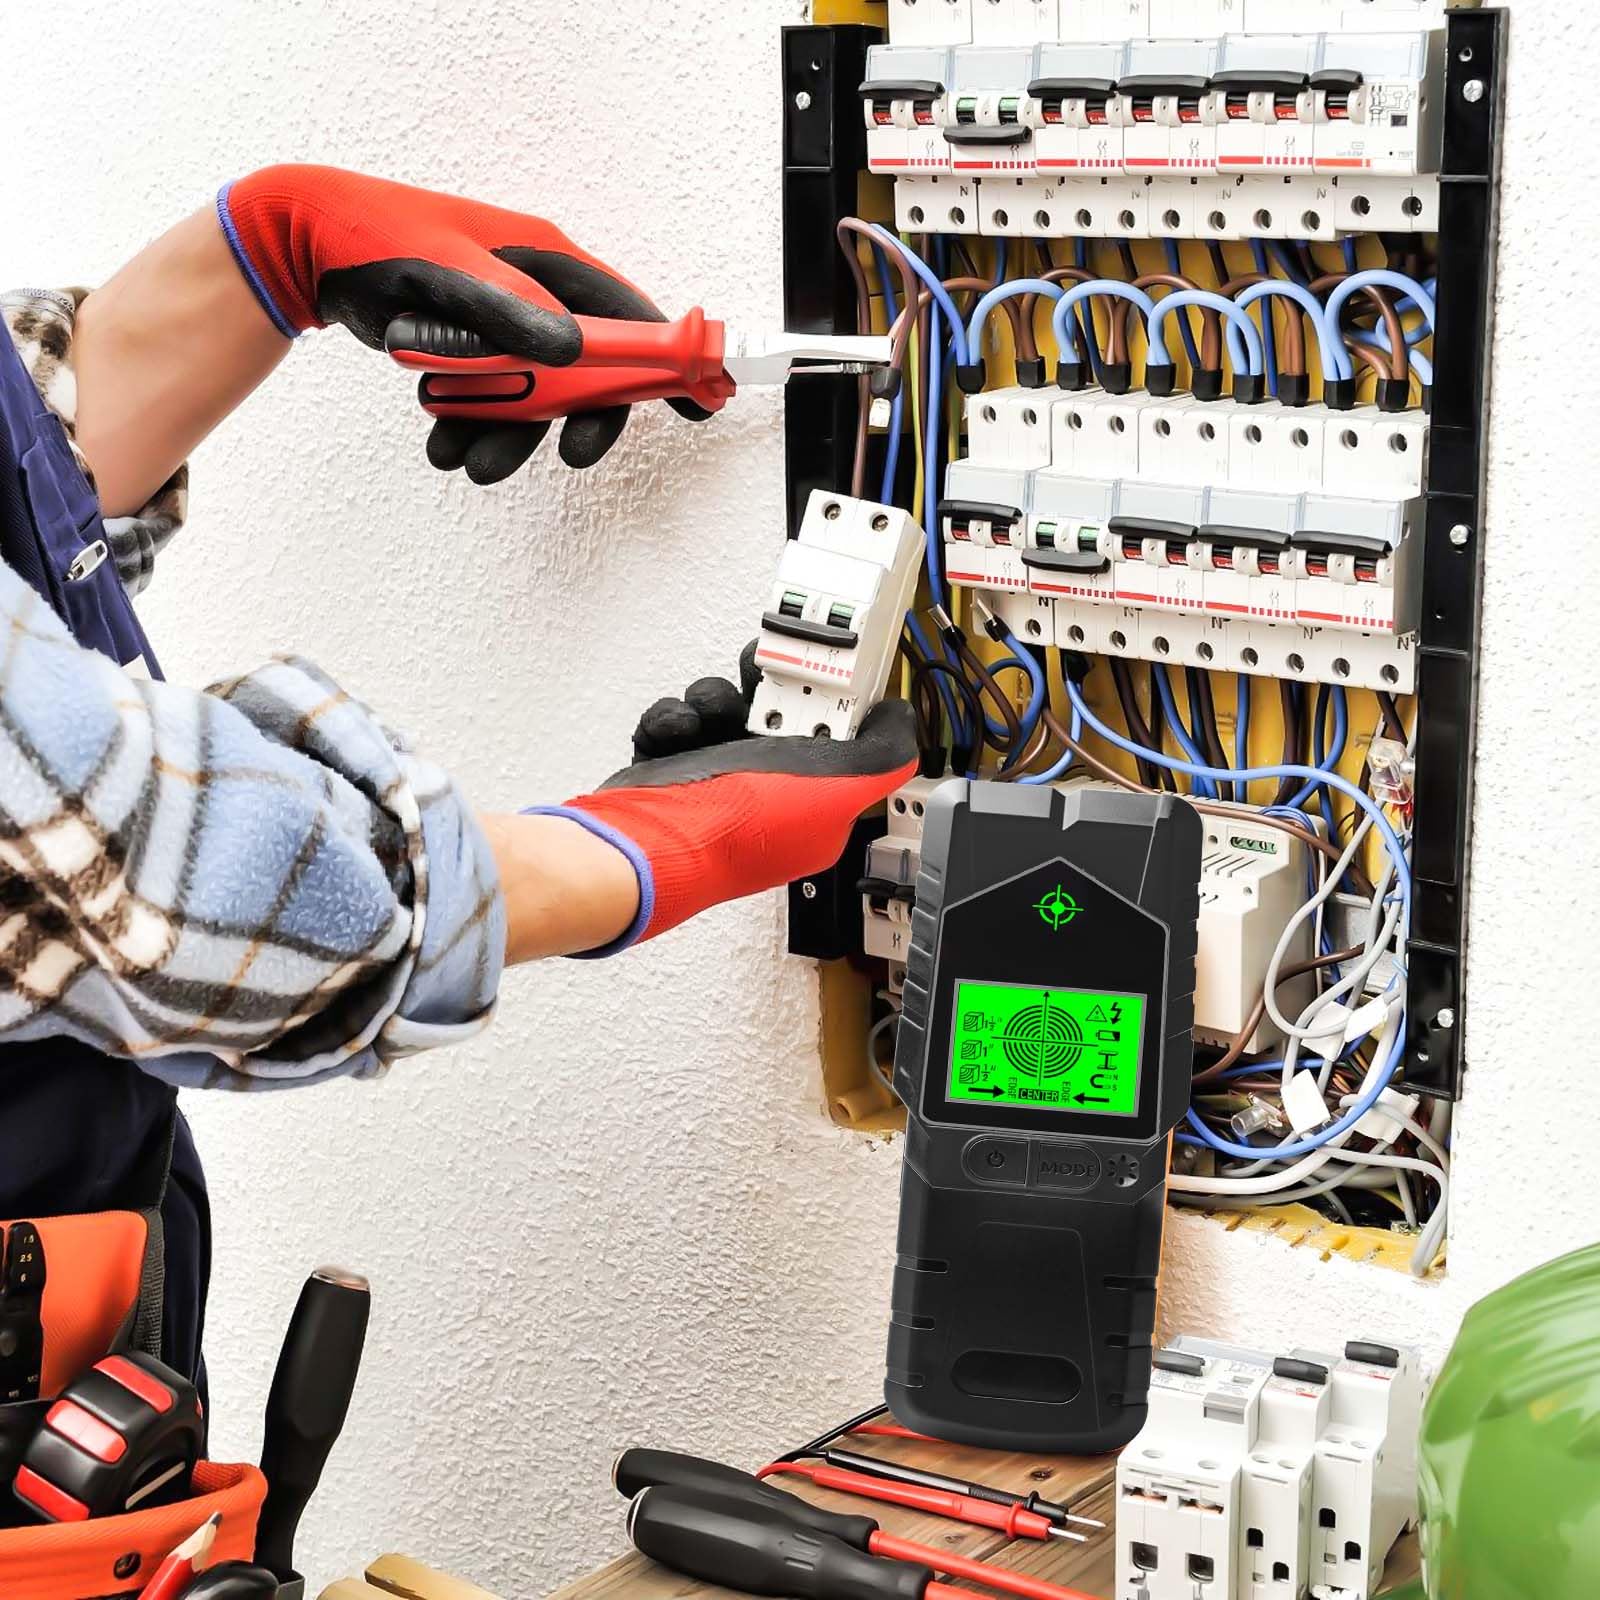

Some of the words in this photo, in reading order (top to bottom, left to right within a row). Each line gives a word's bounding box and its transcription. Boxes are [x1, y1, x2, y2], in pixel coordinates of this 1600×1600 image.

[959, 185, 969, 197] N
[1045, 188, 1055, 200] N
[1222, 188, 1232, 200] N
[1317, 187, 1327, 200] N
[1038, 595, 1049, 607] N
[1211, 616, 1223, 629] N
[1303, 625, 1314, 640] N
[1397, 636, 1409, 650] N
[837, 698, 850, 712] N
[1008, 1076, 1018, 1099] EDGE
[1061, 1081, 1072, 1104] EDGE
[1019, 1088, 1059, 1102] CENTER
[1039, 1160, 1097, 1177] MODE
